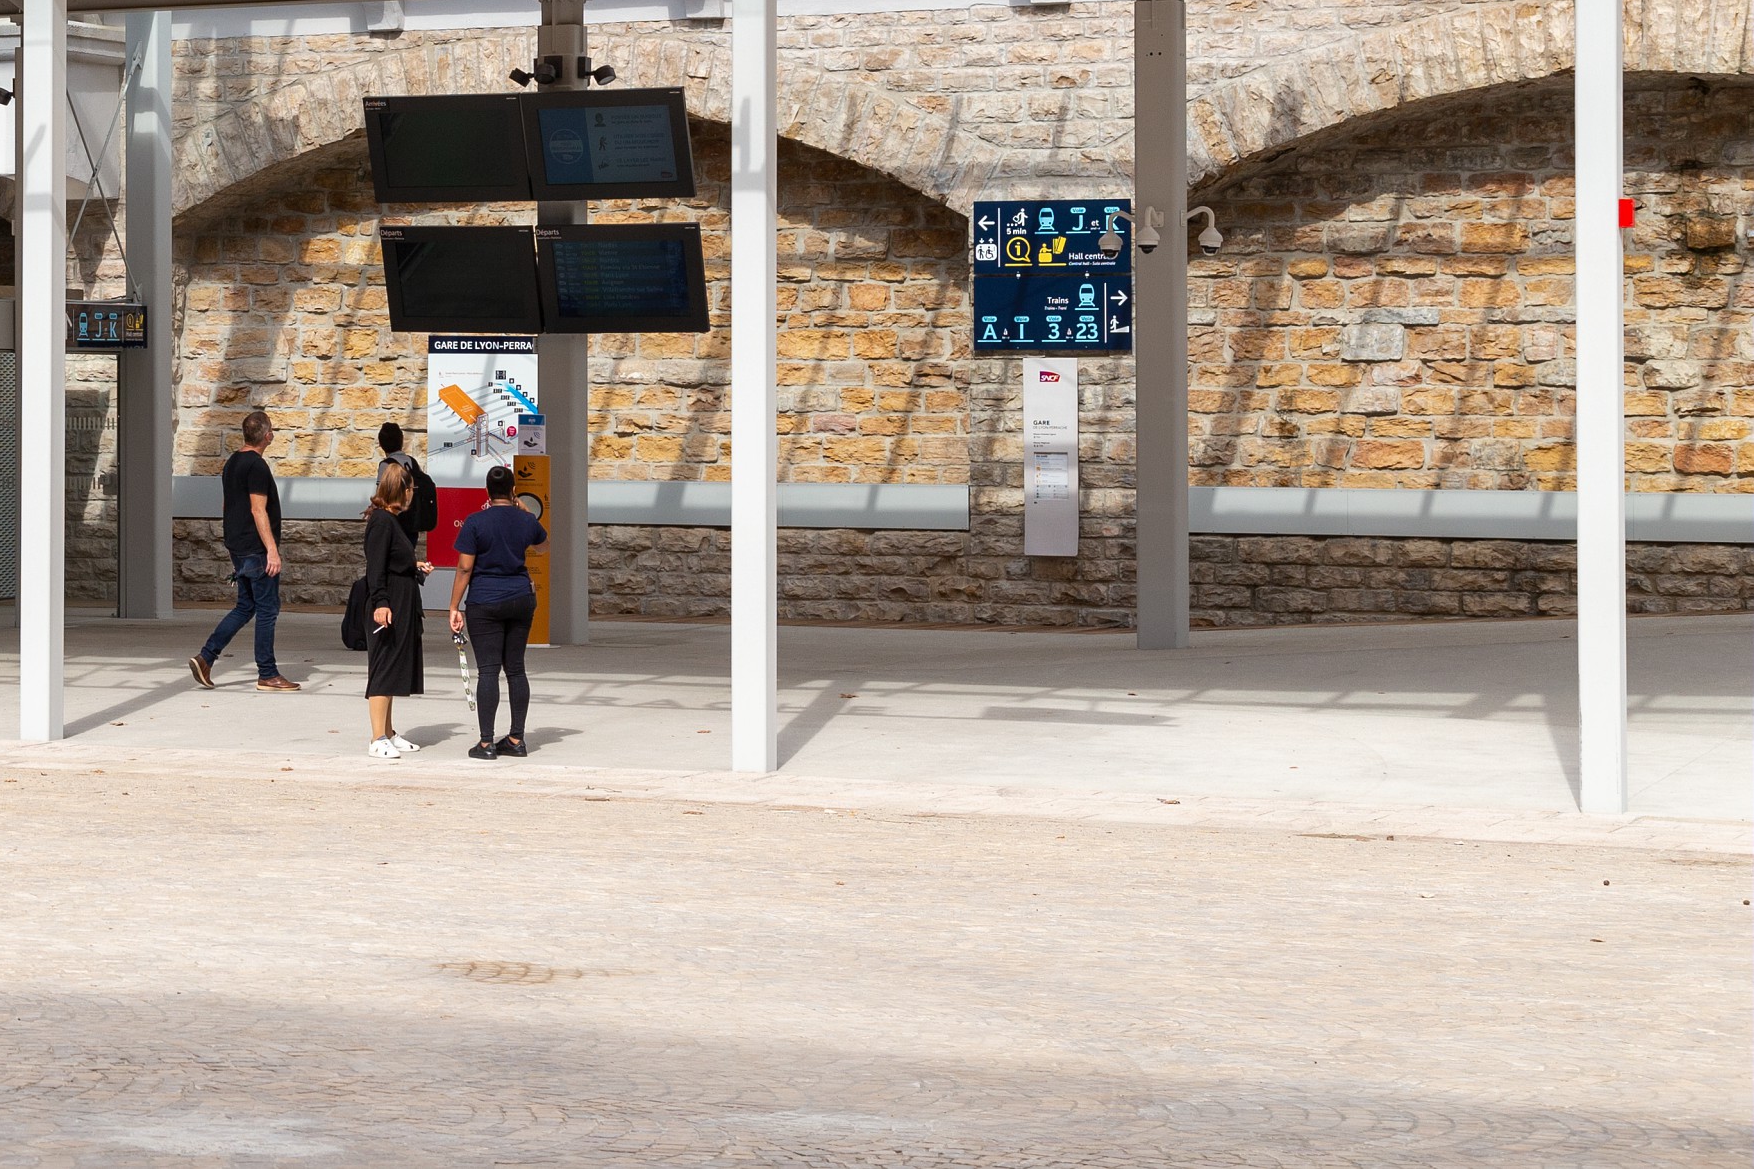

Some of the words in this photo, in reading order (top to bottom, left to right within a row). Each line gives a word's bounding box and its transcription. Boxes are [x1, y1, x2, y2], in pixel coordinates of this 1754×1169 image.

[1072, 214, 1083, 231] J
[1068, 252, 1083, 260] Hall
[1047, 296, 1069, 305] Trains
[95, 321, 102, 338] J
[109, 321, 117, 338] K
[982, 324, 997, 339] A
[1048, 323, 1060, 339] 3
[1076, 323, 1098, 339] 23
[434, 341, 458, 350] GARE
[460, 341, 473, 350] DE
[475, 341, 533, 350] LYON-PERRA
